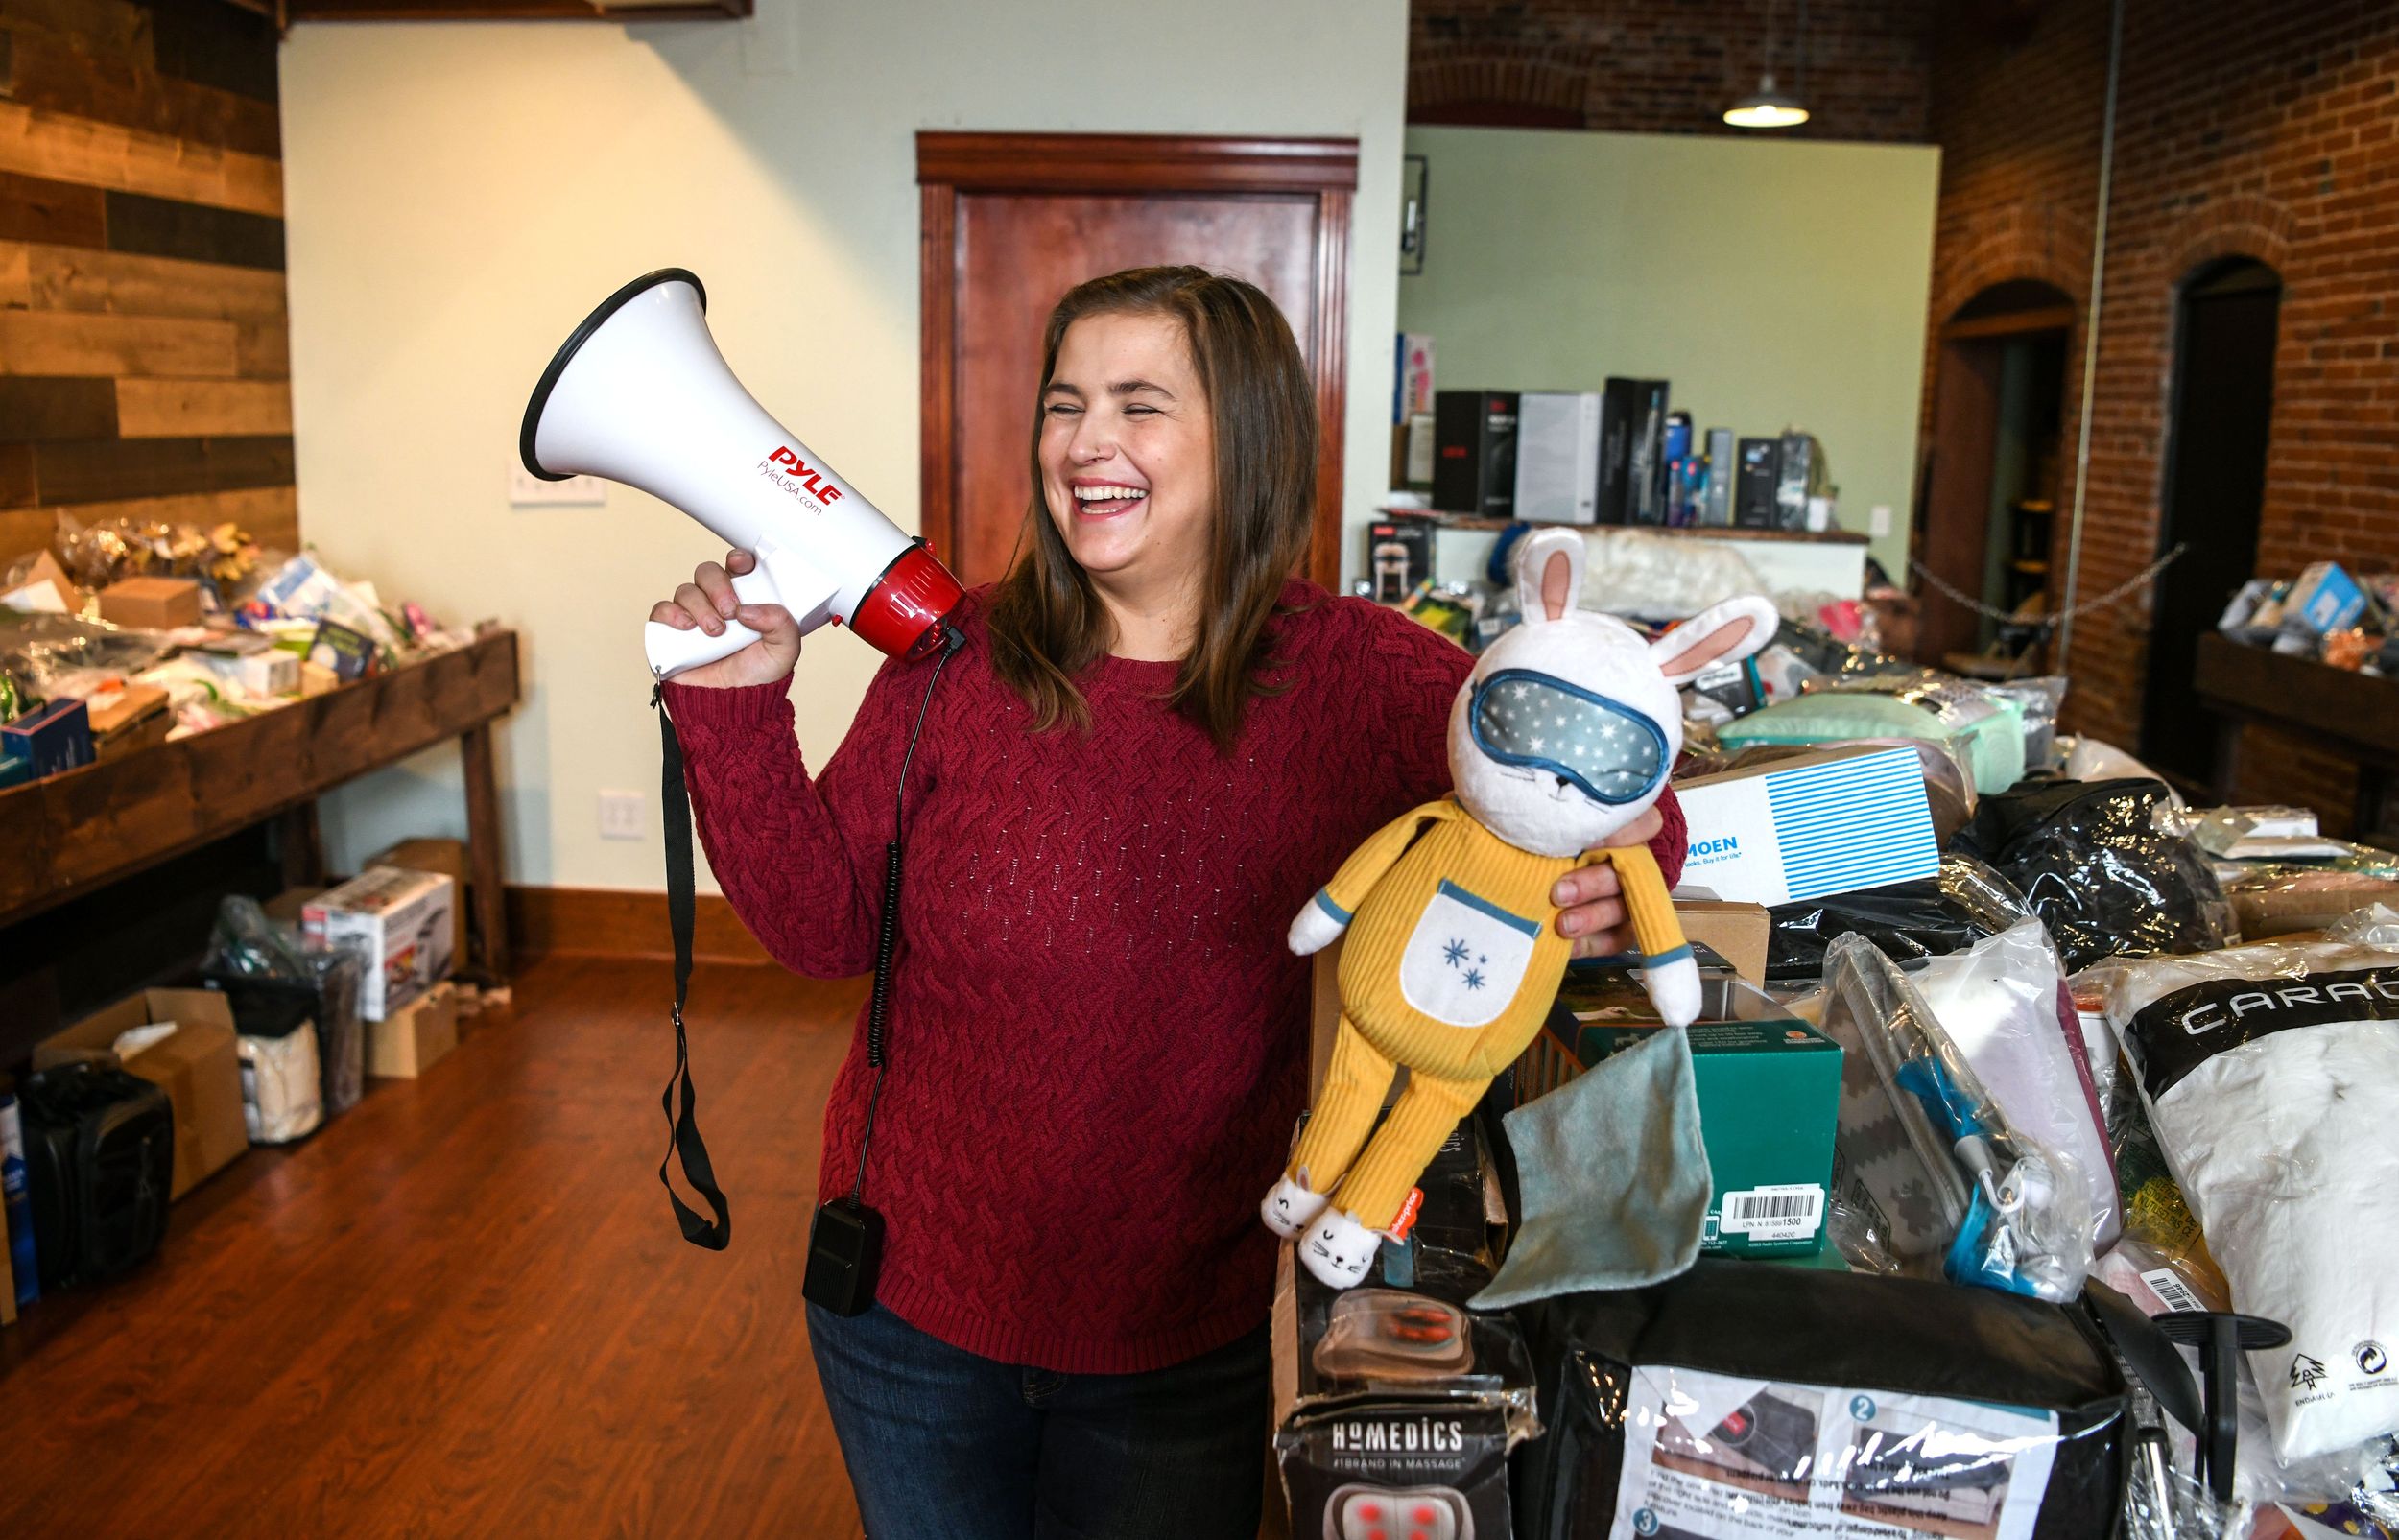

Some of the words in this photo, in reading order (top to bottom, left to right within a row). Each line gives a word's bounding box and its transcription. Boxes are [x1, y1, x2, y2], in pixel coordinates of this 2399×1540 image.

[768, 445, 842, 506] PYLE
[756, 460, 822, 516] PyleUSA.com
[1783, 1217, 1801, 1226] 1500
[2169, 1215, 2183, 1229] PAS
[2181, 1226, 2196, 1238] CE
[1856, 1399, 1869, 1418] 2
[1389, 1457, 1401, 1469] IN
[1639, 1512, 1652, 1533] 3
